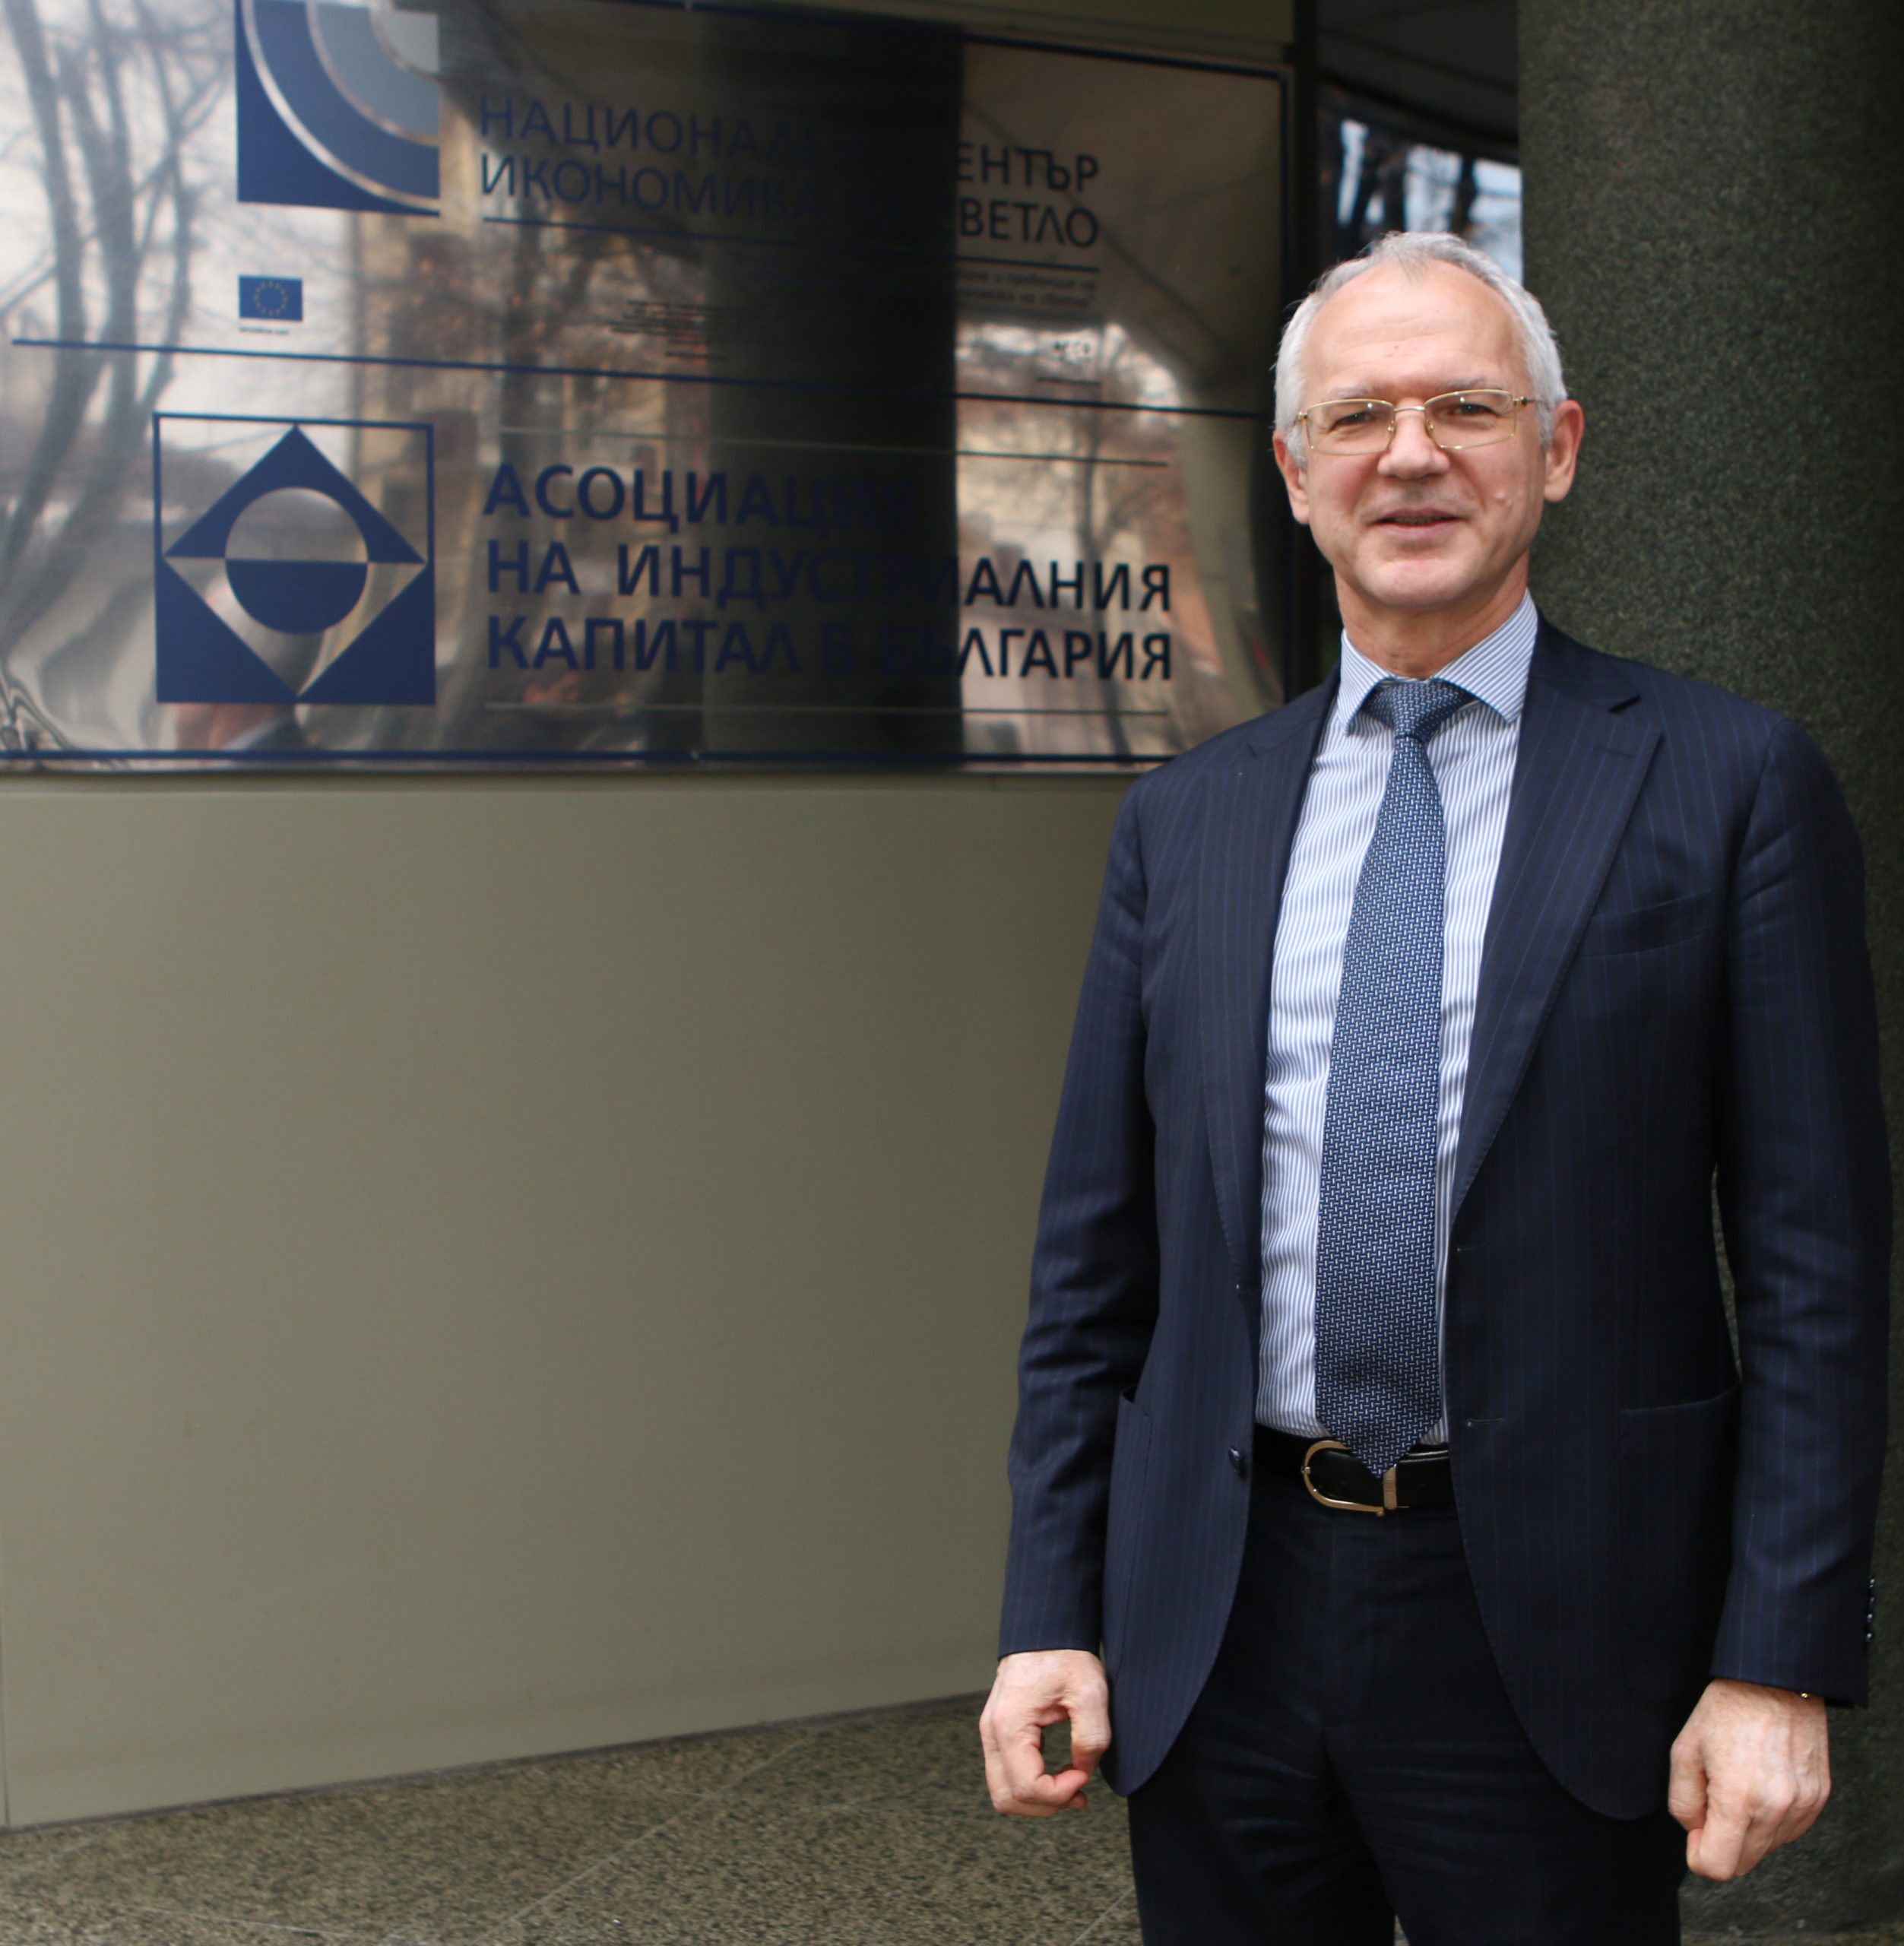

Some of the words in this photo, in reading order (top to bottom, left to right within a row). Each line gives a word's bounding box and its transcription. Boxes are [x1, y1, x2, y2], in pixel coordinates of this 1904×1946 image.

[483, 462, 918, 535] АСОЦИАЦИЯ
[487, 540, 580, 595] НА
[618, 544, 1171, 612] ИНДУСТРИАЛНИЯ
[487, 616, 801, 673] КАПИТАЛ
